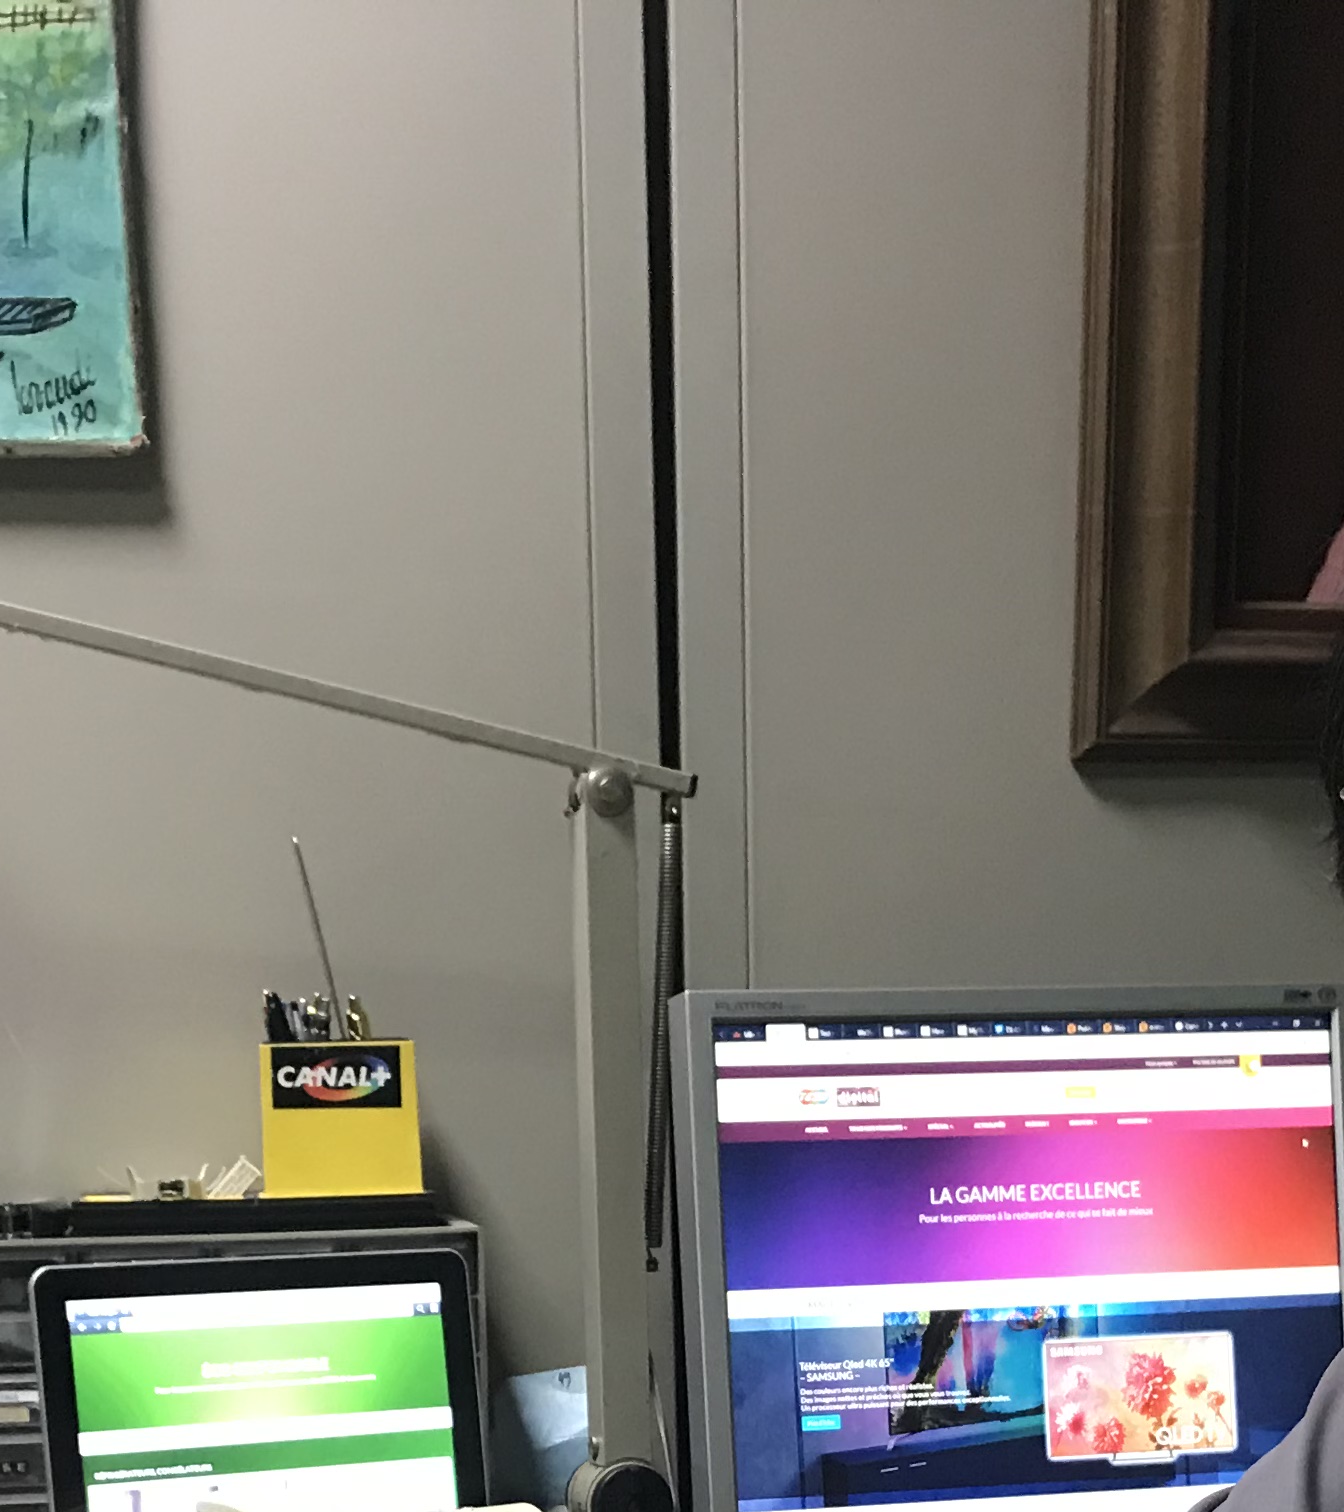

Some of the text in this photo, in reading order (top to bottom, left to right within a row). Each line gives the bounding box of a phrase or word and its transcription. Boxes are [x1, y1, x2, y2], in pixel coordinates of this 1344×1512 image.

[276, 1065, 391, 1088] CANAL+
[930, 1180, 1142, 1205] LA GAMME EXCELLENCE
[918, 1213, 939, 1224] Pour
[940, 1213, 954, 1223] les
[954, 1213, 996, 1224] personnes
[799, 1359, 842, 1372] Téléviseur
[807, 1371, 854, 1382] SAMSUNG
[1156, 1426, 1203, 1445] QLED
